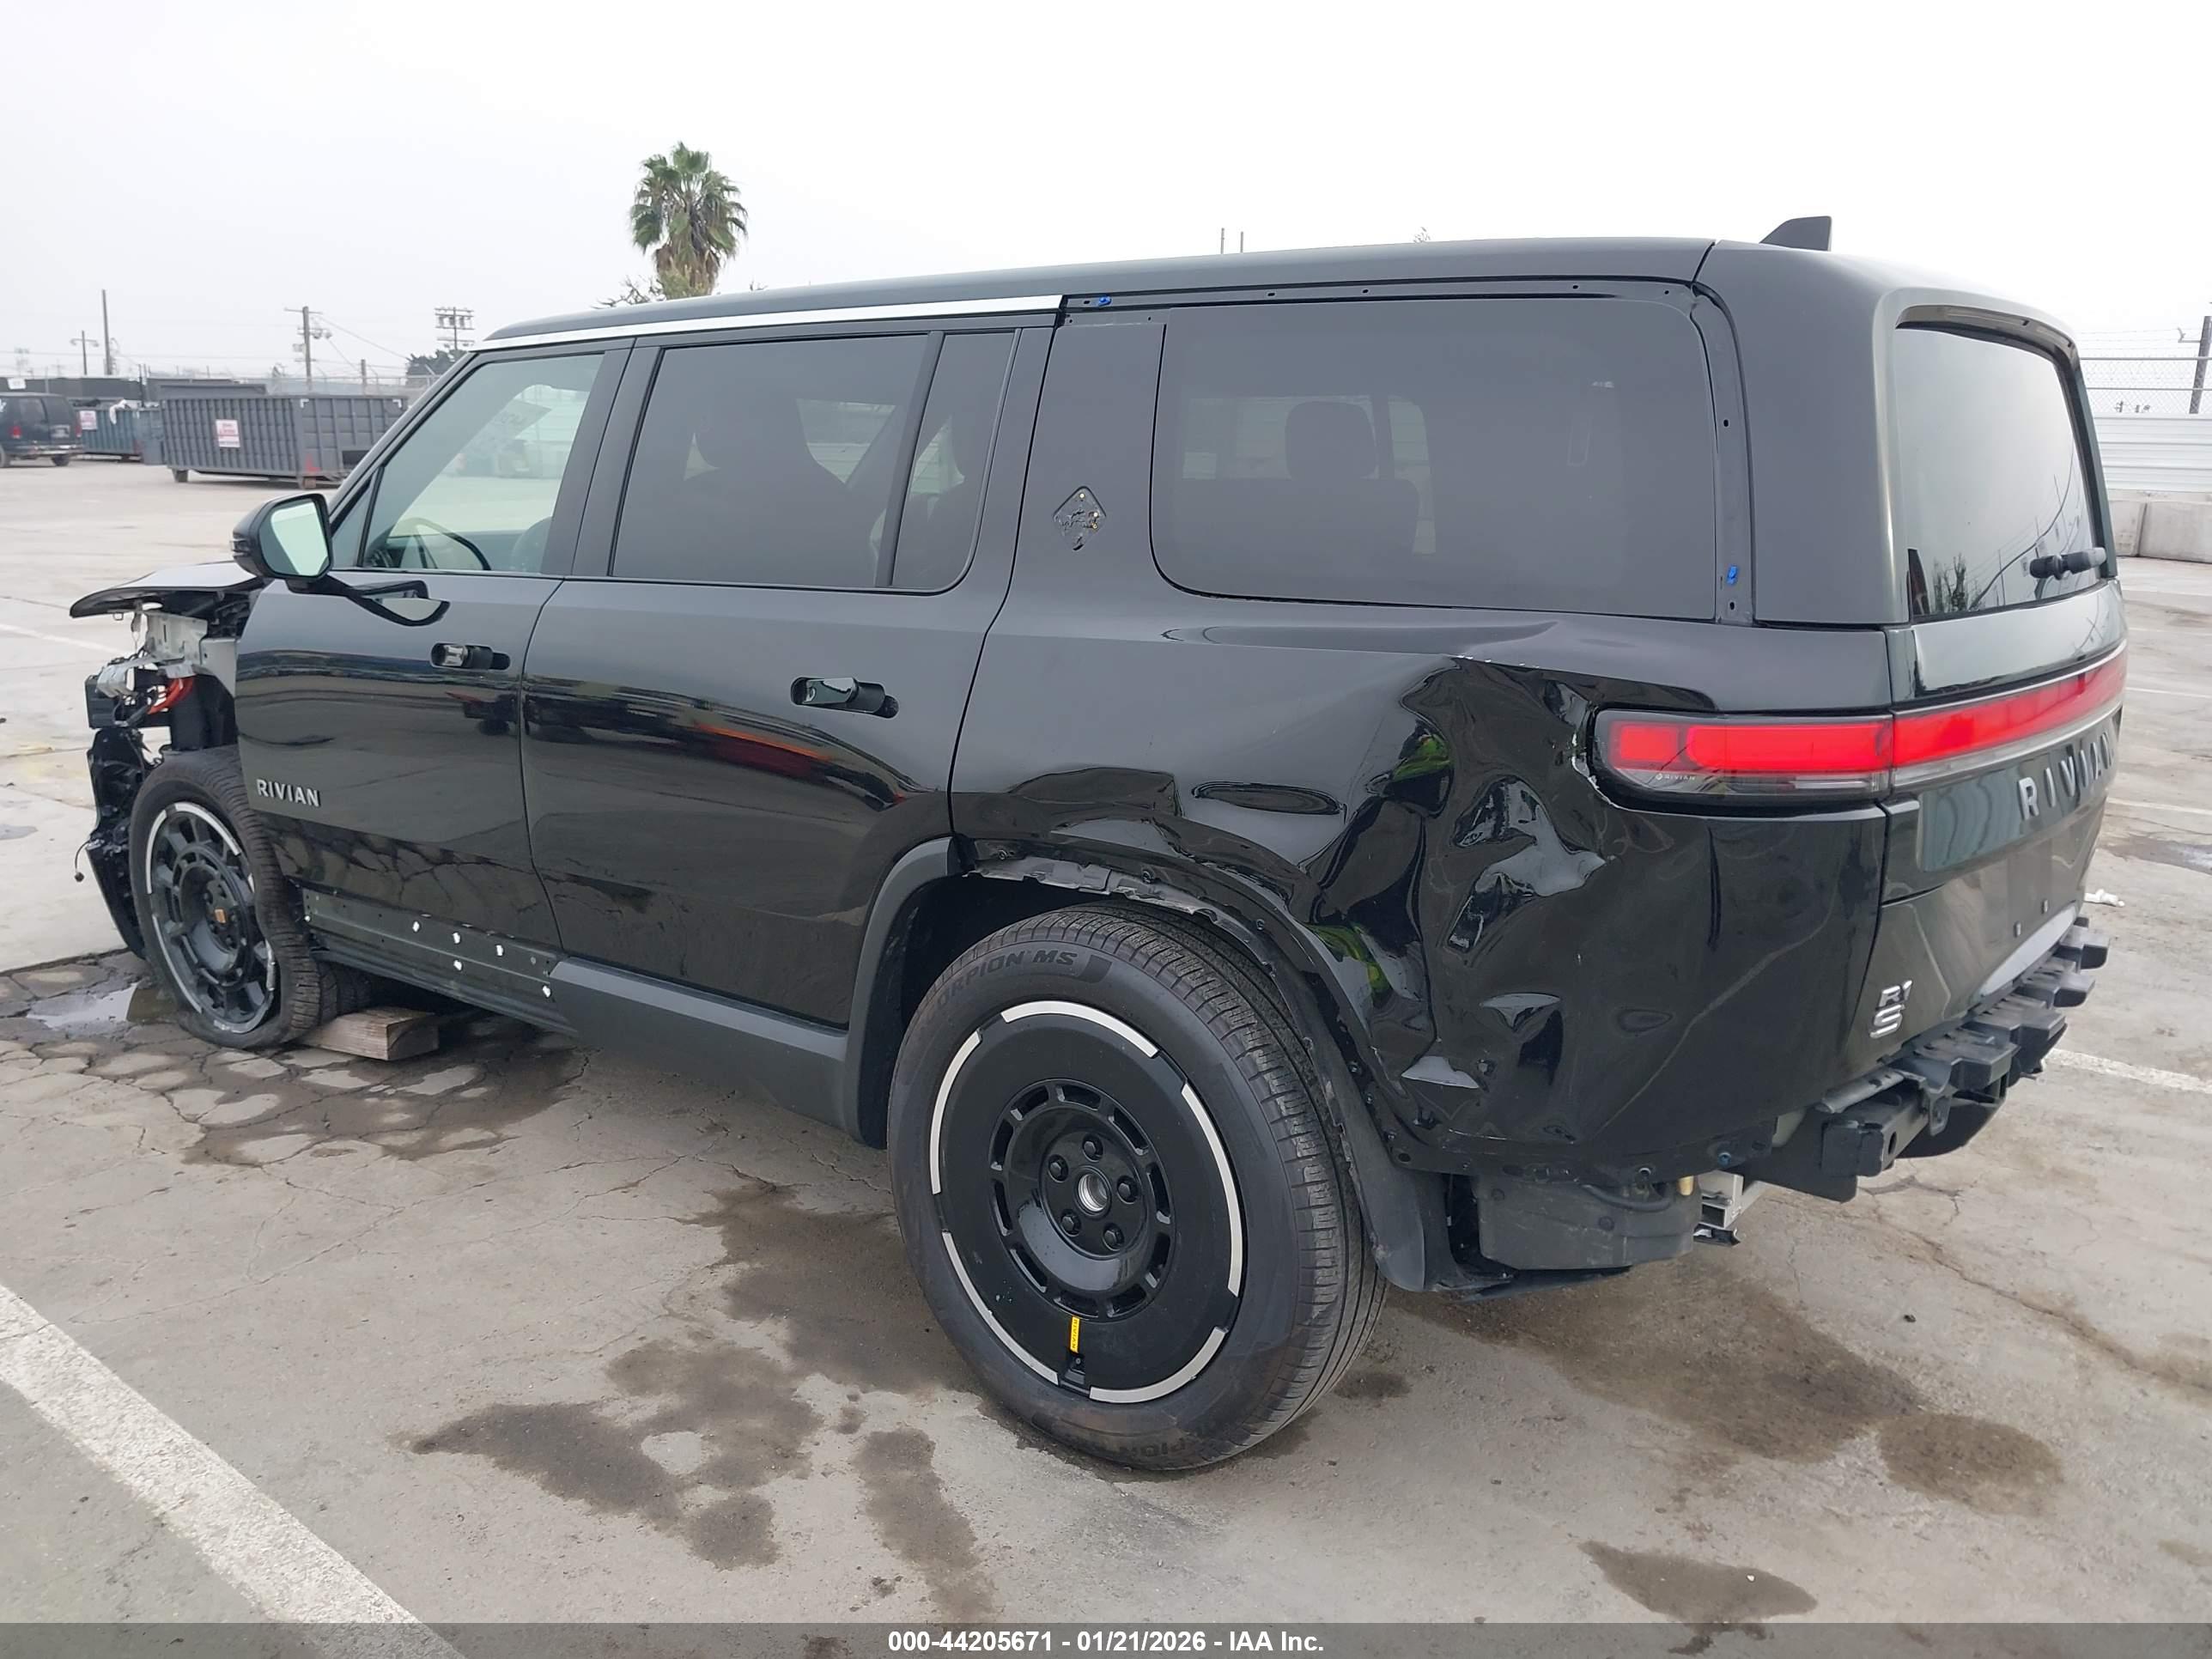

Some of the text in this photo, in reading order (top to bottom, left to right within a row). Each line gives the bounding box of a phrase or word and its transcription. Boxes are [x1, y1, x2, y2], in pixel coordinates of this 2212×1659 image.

[2017, 732, 2114, 820] RIVIAN
[257, 778, 320, 806] RIVIAN
[1033, 950, 1078, 965] MS
[1879, 980, 1912, 1007] R1
[1869, 1004, 1905, 1039] S
